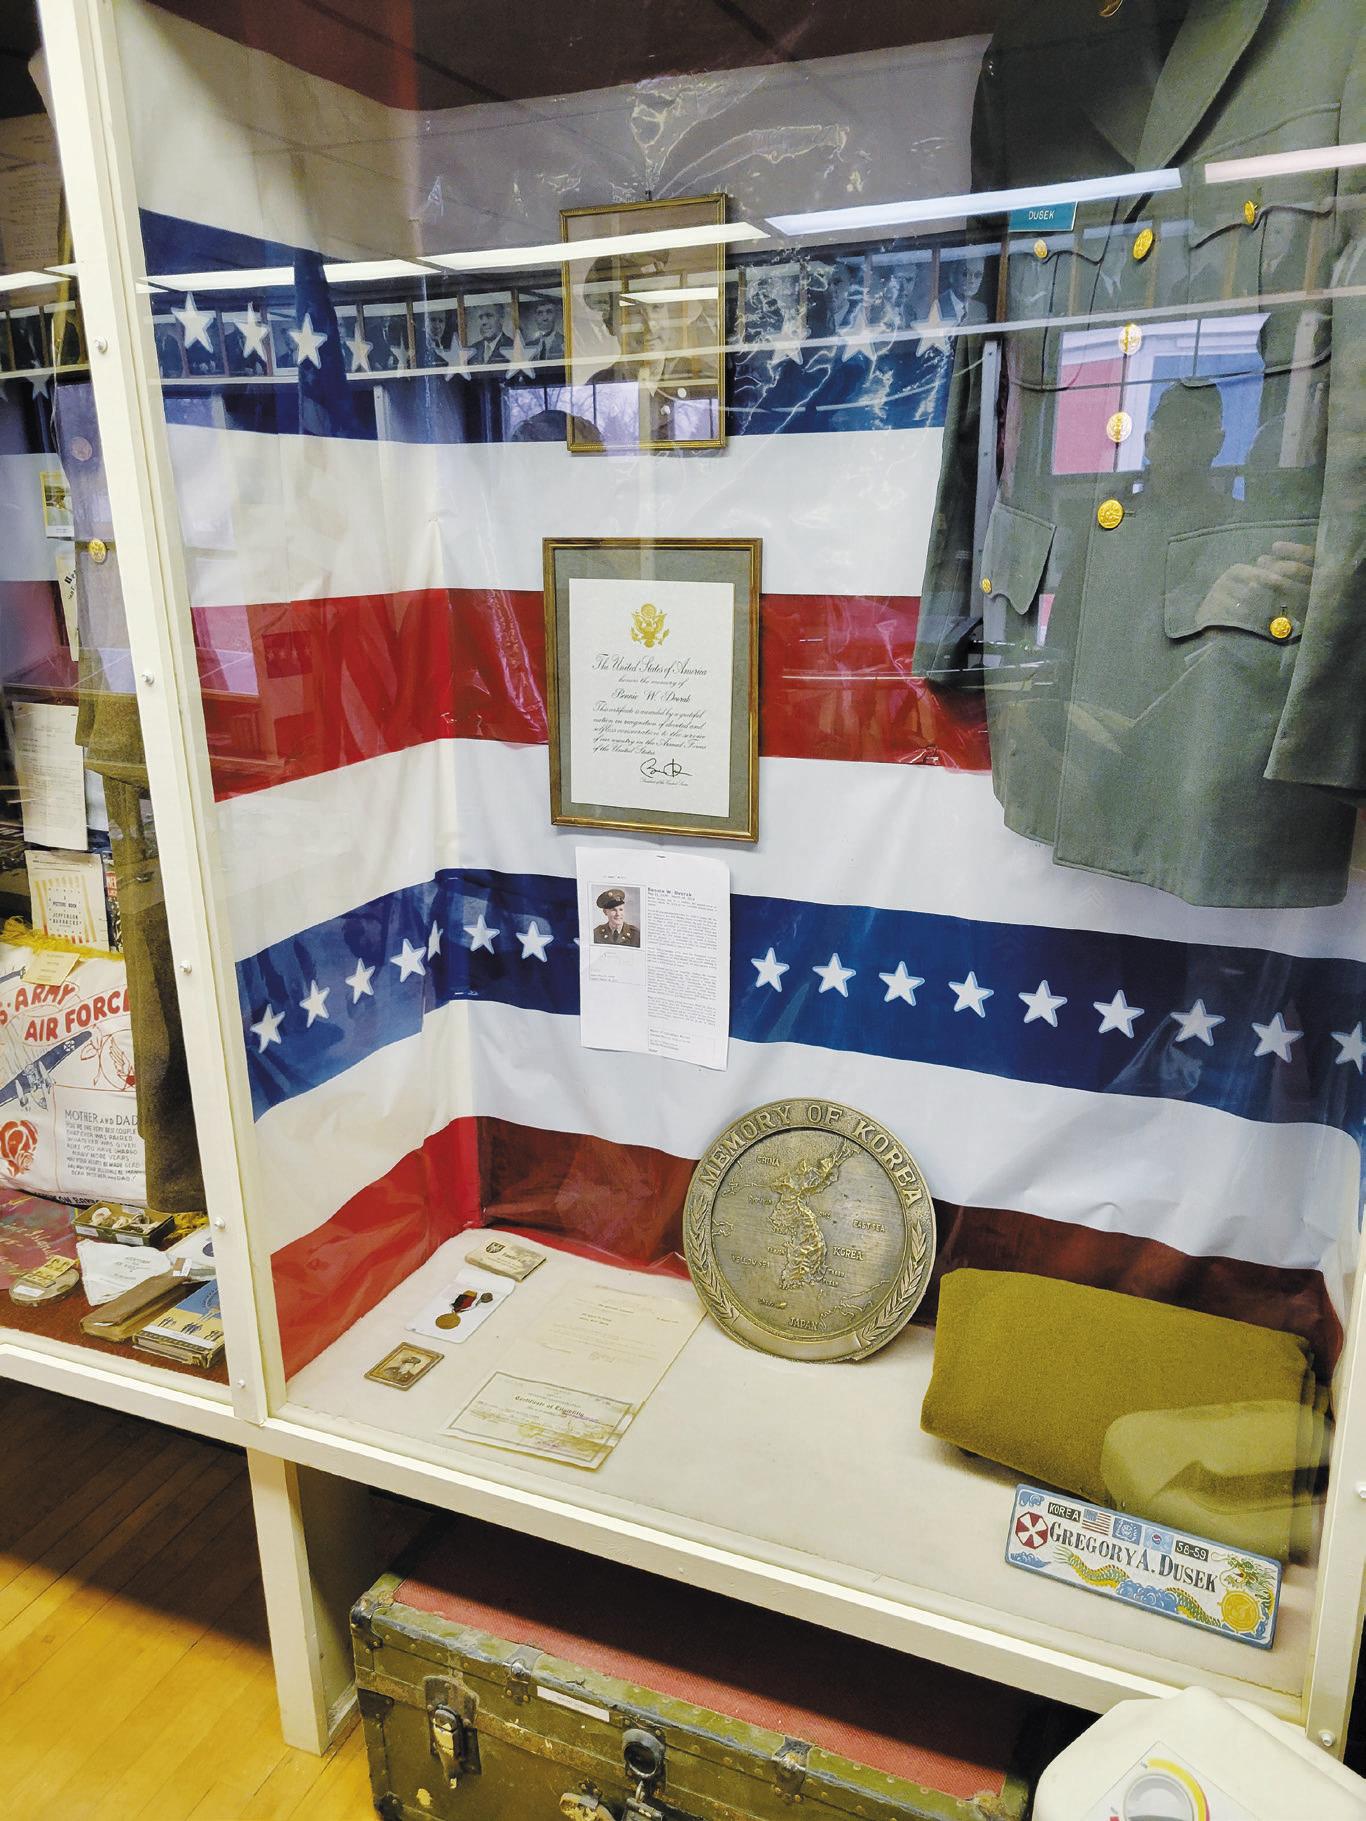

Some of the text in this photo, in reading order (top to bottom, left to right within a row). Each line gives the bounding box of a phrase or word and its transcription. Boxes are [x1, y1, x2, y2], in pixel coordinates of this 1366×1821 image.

[1029, 210, 1054, 220] DUSEK
[592, 654, 707, 678] The United States of America
[640, 676, 648, 684] the
[678, 678, 688, 688] of
[15, 984, 76, 1012] ARMY
[24, 1017, 58, 1042] AIR
[65, 1109, 98, 1123] MOTHER
[116, 1114, 138, 1125] DAD
[97, 1146, 112, 1154] HAVE
[700, 1105, 922, 1208] MEMORY OF KOREA
[853, 1220, 886, 1232] EAST SEA
[833, 1247, 864, 1260] KOREA
[731, 1255, 770, 1268] YELLOW SEA
[789, 1318, 818, 1330] JAPAN
[1049, 1504, 1206, 1560] KOREA 58-59
[1049, 1521, 1218, 1592] GREGORY A. DUSEK
